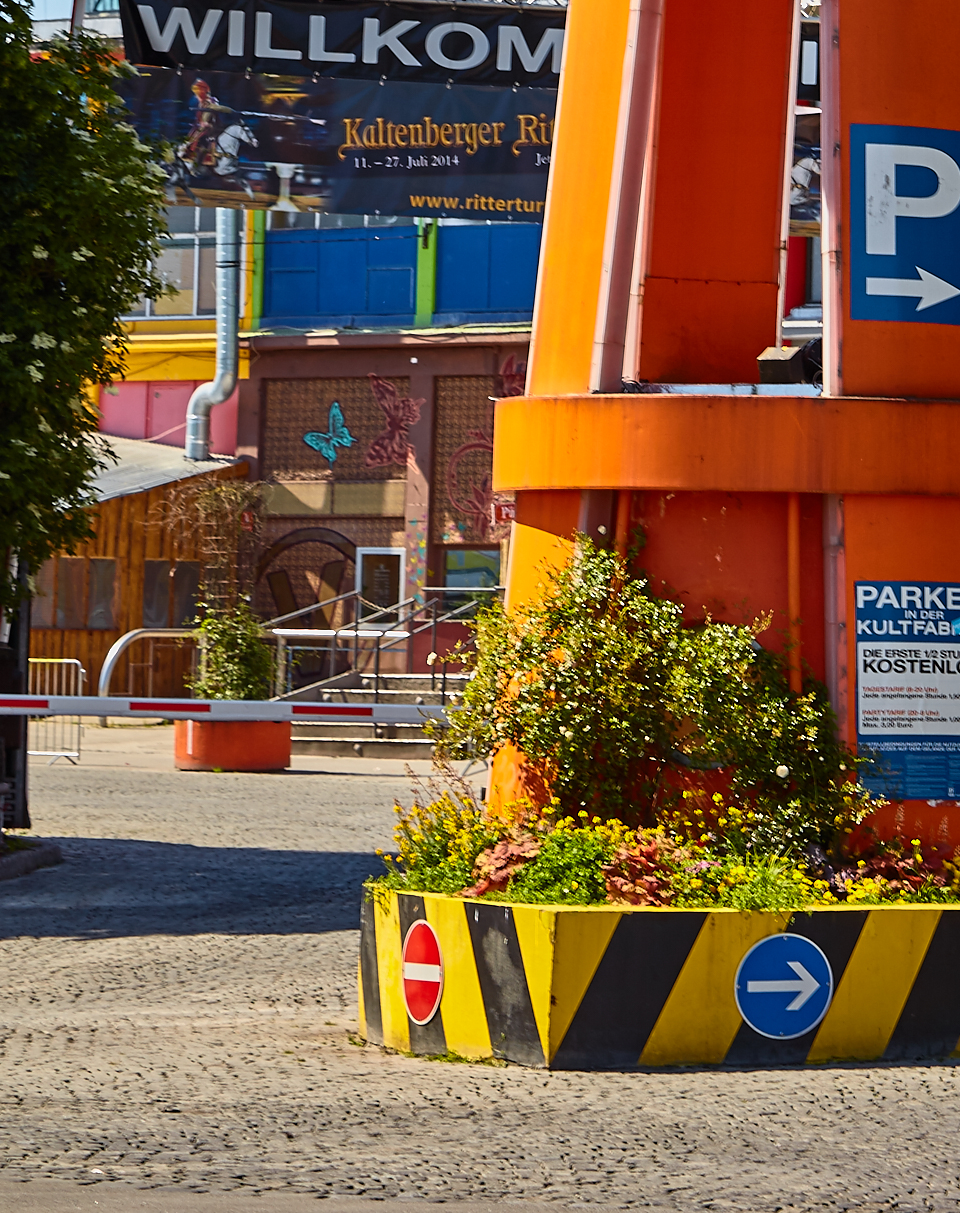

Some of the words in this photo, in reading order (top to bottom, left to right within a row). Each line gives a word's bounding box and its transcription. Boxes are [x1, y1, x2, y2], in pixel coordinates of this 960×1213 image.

[338, 116, 506, 161] Kaltenberger
[406, 155, 429, 170] Juli
[431, 154, 460, 167] 2014
[904, 610, 917, 619] IN
[920, 611, 945, 620] DER
[863, 648, 882, 658] DIE
[885, 649, 922, 659] ERSTE
